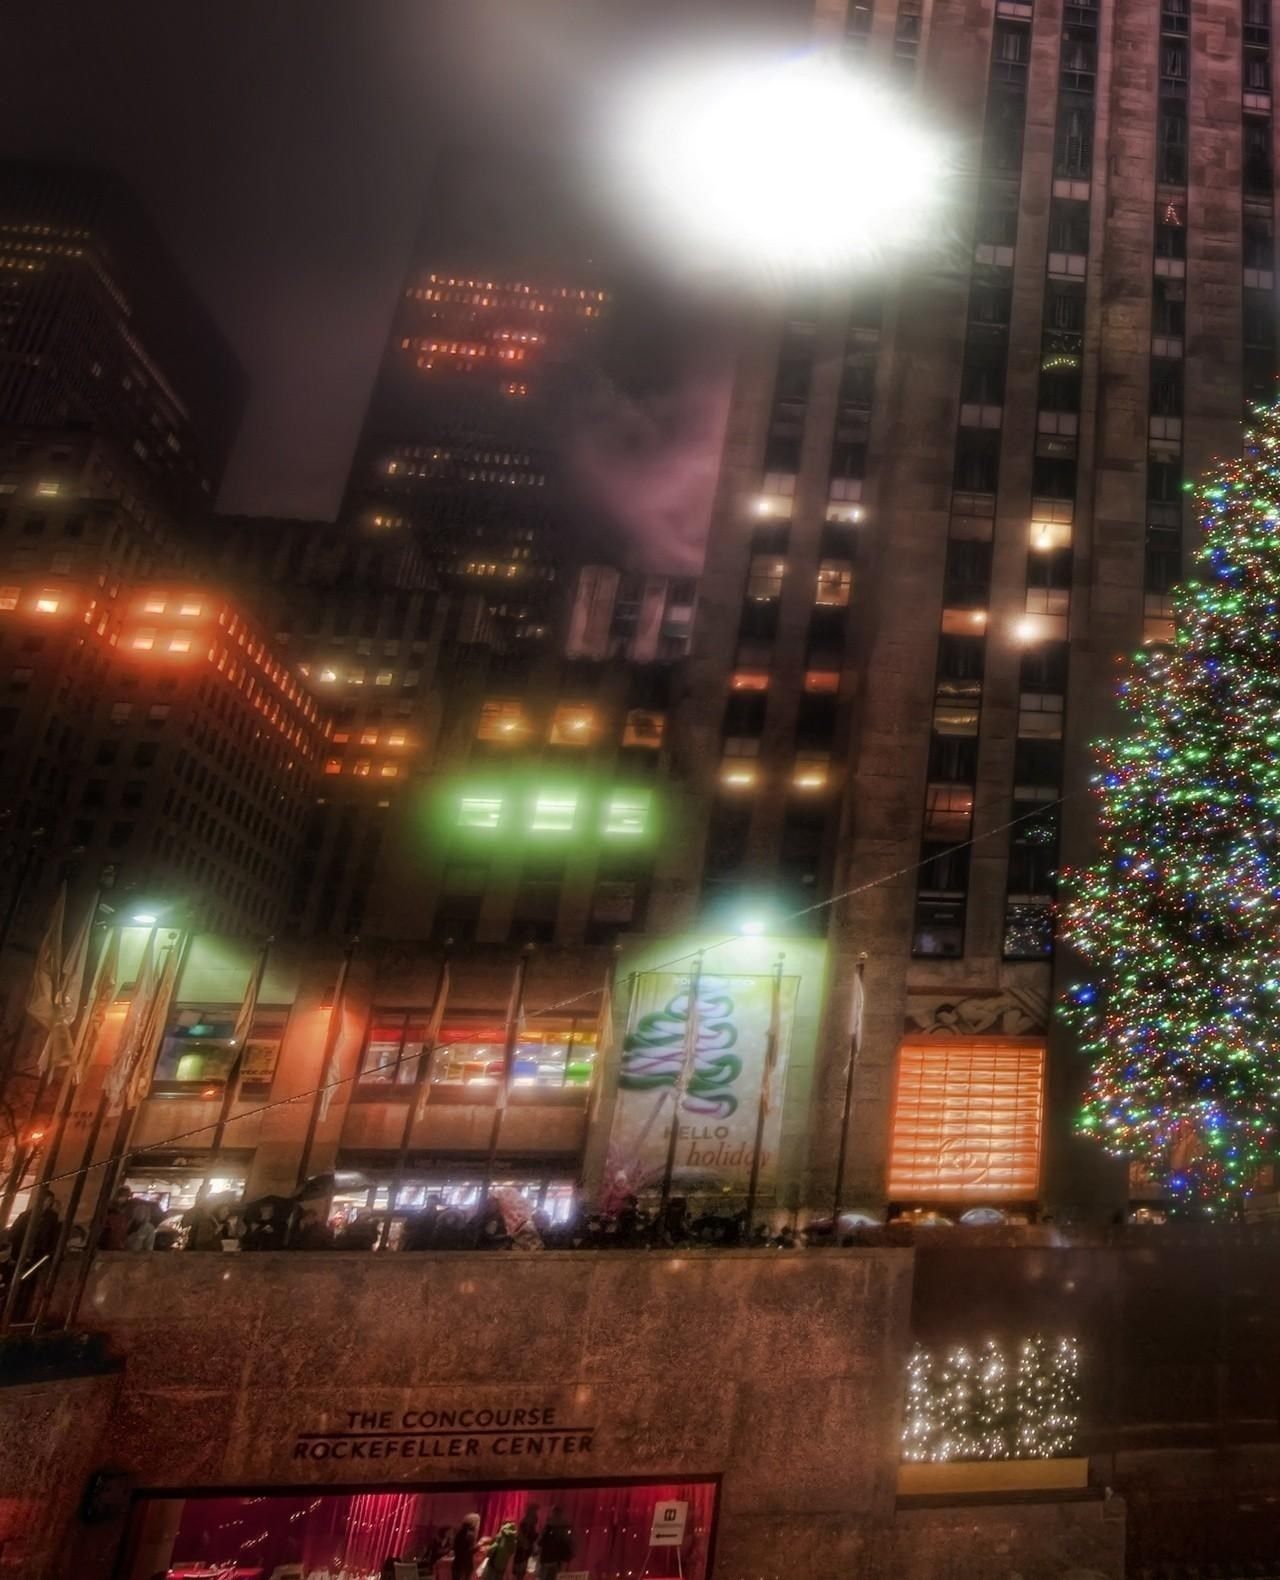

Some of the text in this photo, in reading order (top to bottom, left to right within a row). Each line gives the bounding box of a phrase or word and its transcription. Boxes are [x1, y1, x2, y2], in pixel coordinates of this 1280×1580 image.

[346, 1407, 557, 1430] THE CONCOURSE
[293, 1435, 595, 1461] ROCKEFELLER CENTER
